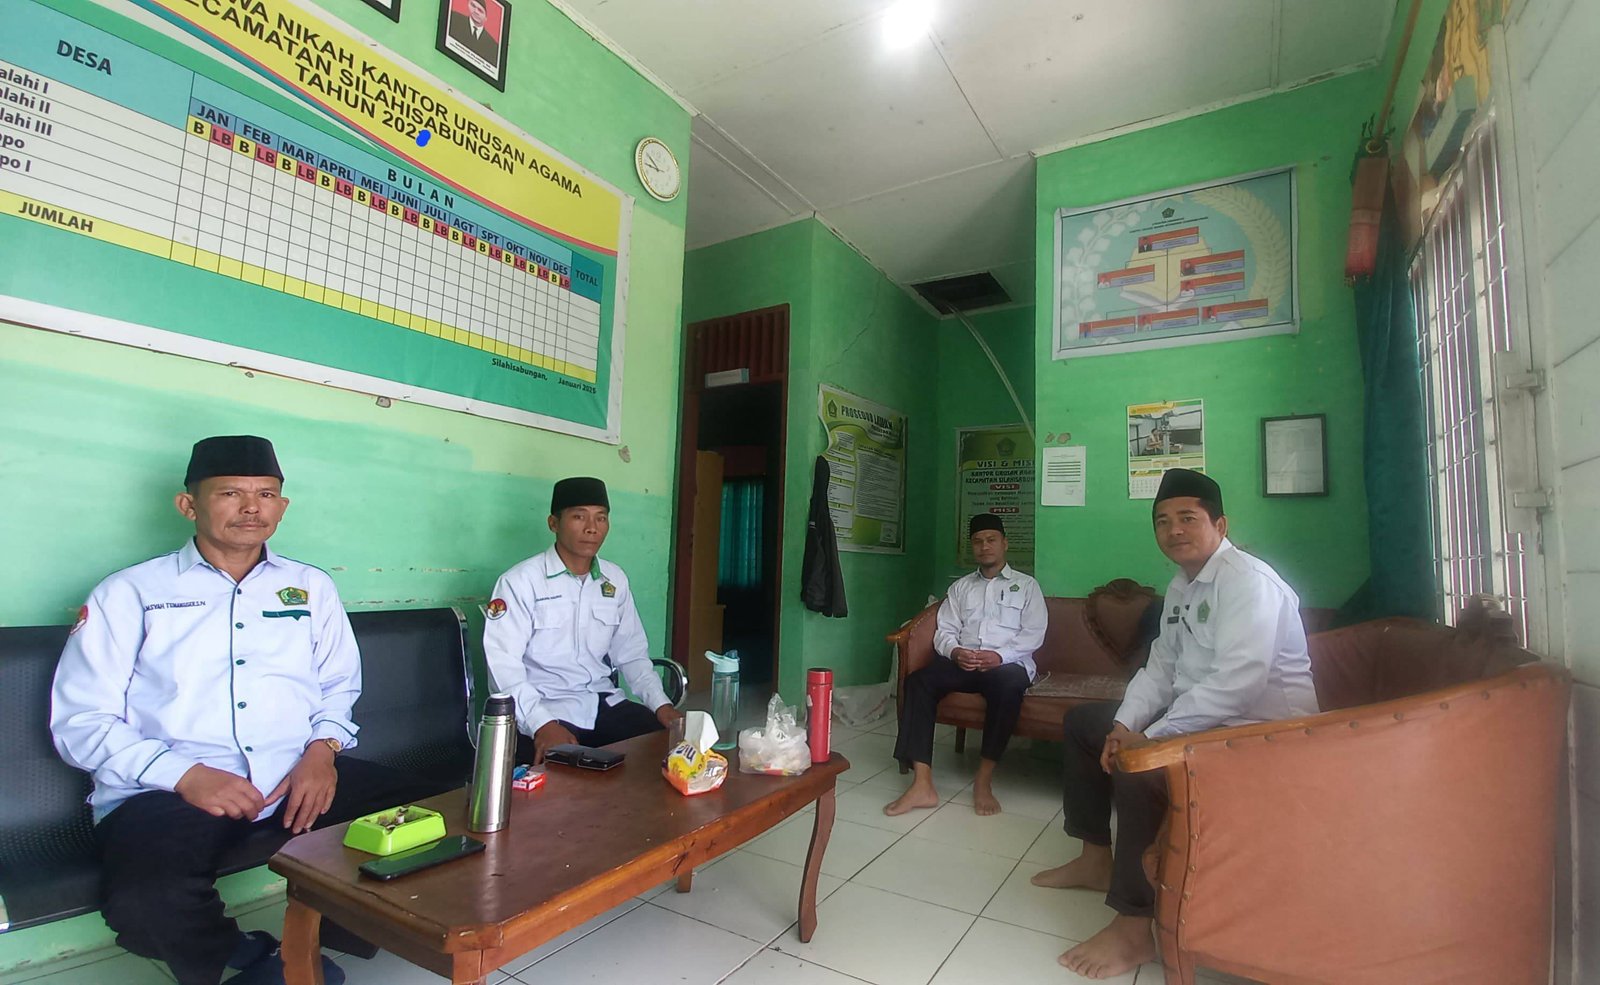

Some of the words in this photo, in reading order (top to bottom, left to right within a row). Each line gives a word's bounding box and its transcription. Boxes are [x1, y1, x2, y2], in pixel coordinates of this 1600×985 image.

[56, 39, 112, 76] DESA
[0, 87, 36, 109] lahi
[39, 100, 50, 114] II
[43, 82, 48, 94] I
[184, 0, 331, 76] CAMATAN
[339, 68, 514, 175] SILAHISABUNGAN
[278, 12, 354, 68] NIKAH
[362, 60, 448, 122] KANTOR
[454, 113, 525, 165] URUSAN
[528, 158, 582, 198] AGAMA
[294, 62, 375, 118] TAHUN
[382, 110, 431, 147] 202
[0, 132, 25, 148] po
[35, 120, 52, 136] III
[25, 159, 31, 172] I
[194, 121, 204, 134] B
[212, 129, 232, 146] LB
[240, 140, 249, 153] B
[256, 147, 275, 164] LB
[282, 158, 291, 171] B
[298, 165, 314, 180] LB
[321, 174, 330, 187] B
[336, 181, 352, 196] LB
[358, 190, 366, 202] B
[372, 196, 386, 210] LB
[391, 205, 399, 216] B
[404, 210, 418, 223] LB
[423, 218, 430, 229] B
[435, 223, 447, 236] LB
[452, 231, 459, 241] B
[463, 235, 475, 247] LB
[480, 241, 485, 252] B
[490, 247, 500, 259] LB
[505, 253, 511, 263] B
[515, 258, 525, 269] LB
[529, 264, 534, 273] B
[538, 268, 548, 278] LB
[551, 273, 557, 283] B
[560, 278, 569, 288] LB
[197, 105, 229, 127] JAN
[243, 124, 271, 145] FEB
[282, 141, 315, 164] MAR
[320, 158, 354, 182] APRL
[360, 176, 383, 194] MEI
[391, 190, 418, 210] JUNI
[424, 204, 446, 222] JULI
[454, 218, 474, 234] AGT
[482, 230, 500, 245] SPT
[506, 241, 525, 256] OKT
[529, 252, 548, 266] NOV
[553, 262, 568, 276] DES
[575, 270, 598, 286] TOTAL
[388, 168, 454, 208] BULAN
[18, 200, 94, 233] JUMLAH
[558, 377, 581, 390] Januari
